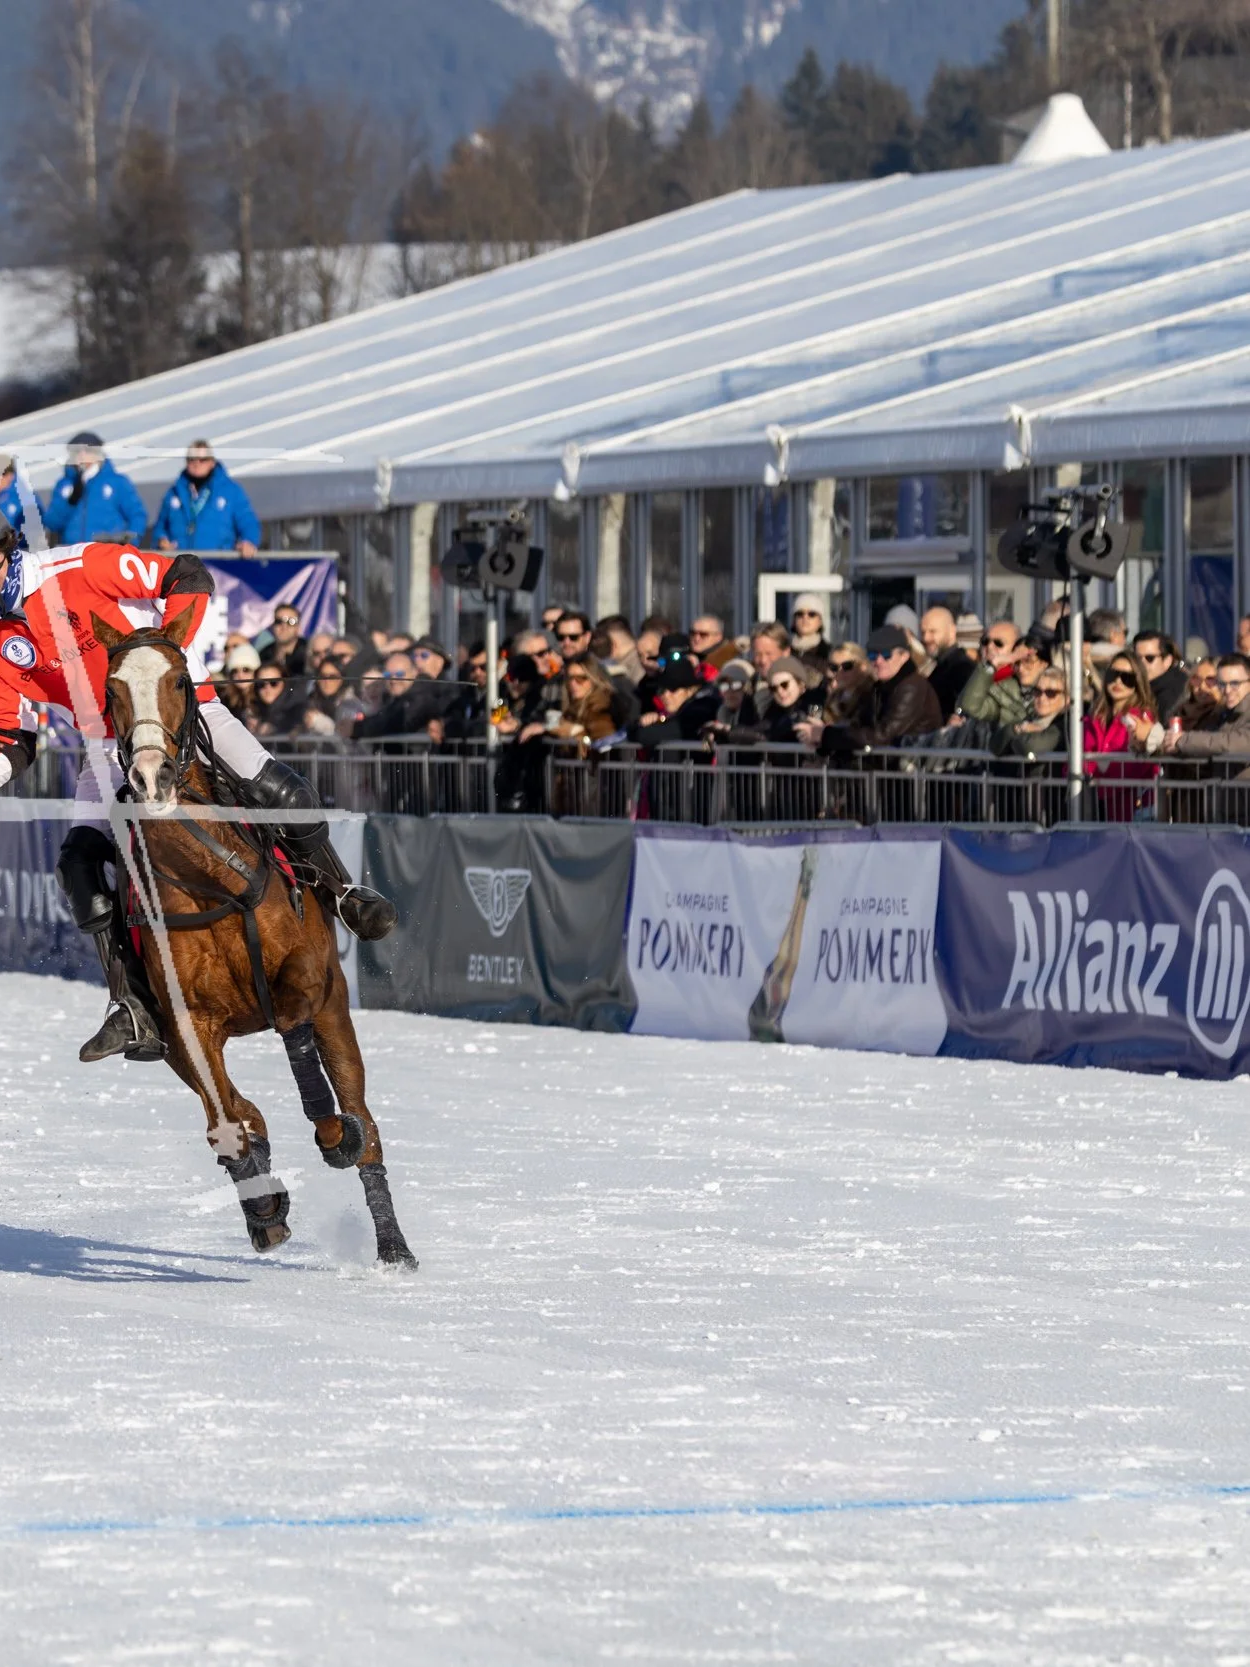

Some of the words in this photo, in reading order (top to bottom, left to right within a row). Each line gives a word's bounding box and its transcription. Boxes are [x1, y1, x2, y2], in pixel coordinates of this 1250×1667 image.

[119, 552, 159, 591] 2
[839, 897, 910, 917] CHAMPAGNE
[467, 953, 525, 985] BENTLEY
[813, 927, 934, 984] POMMERY
[1001, 888, 1180, 1018] Allianz
